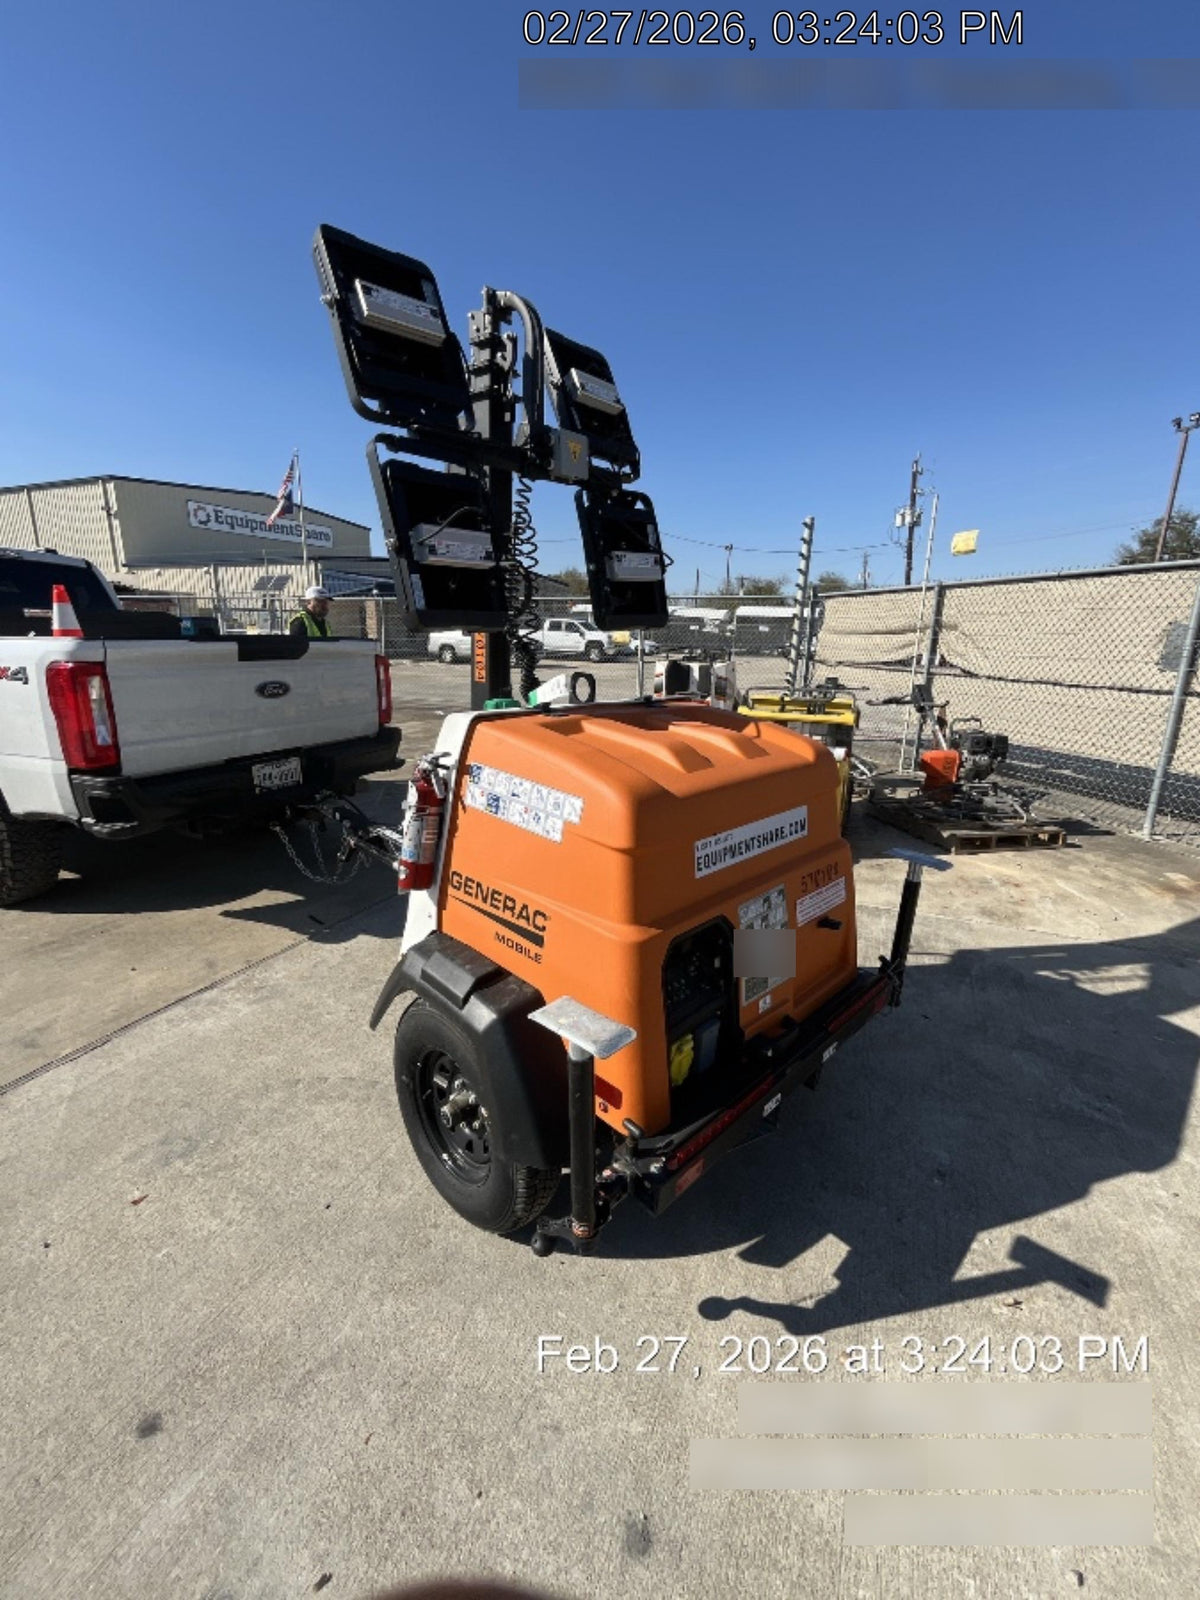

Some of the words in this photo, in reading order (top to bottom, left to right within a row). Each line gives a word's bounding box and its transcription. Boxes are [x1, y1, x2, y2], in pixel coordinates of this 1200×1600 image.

[696, 817, 806, 872] EQUIPMENTSHARE.COM
[450, 870, 547, 933] GENERAC
[494, 931, 542, 965] MOBILE
